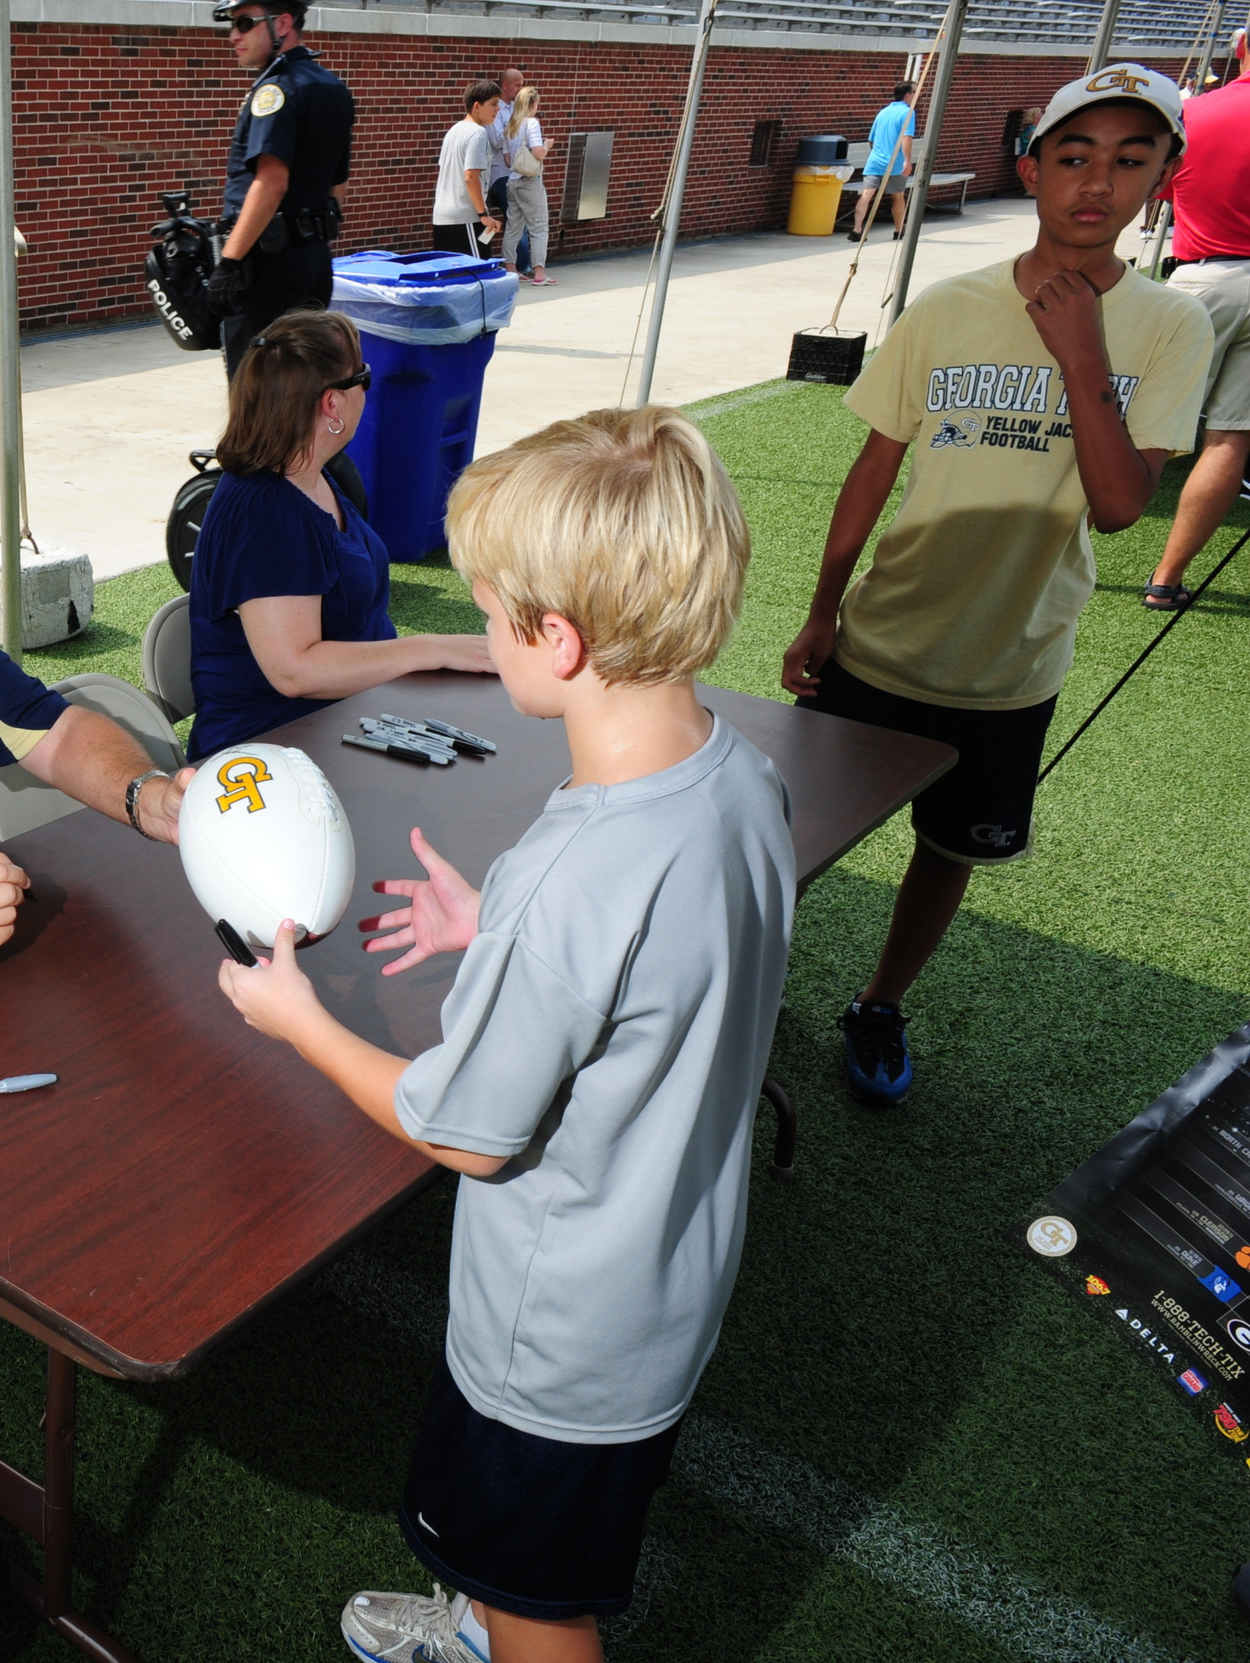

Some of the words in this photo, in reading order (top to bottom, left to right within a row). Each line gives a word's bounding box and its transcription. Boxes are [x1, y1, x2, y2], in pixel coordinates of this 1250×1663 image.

[1085, 69, 1149, 93] GT
[147, 279, 193, 341] POLICE
[926, 363, 1053, 413] GEORGIA
[985, 415, 1043, 435] YELLOW
[1044, 421, 1074, 439] JAC
[980, 430, 1050, 453] FOOTBALL
[215, 756, 273, 814] GT
[1041, 1221, 1069, 1246] GT
[1200, 1215, 1231, 1242] CLEMSON
[1181, 1250, 1200, 1267] DUKE
[1130, 1318, 1175, 1363] DELTA
[1151, 1298, 1233, 1382] WWW.RAMBLINWRECK.COM
[1154, 1290, 1245, 1379] 1-888-TECH-TIX
[1213, 1404, 1238, 1430] 790
